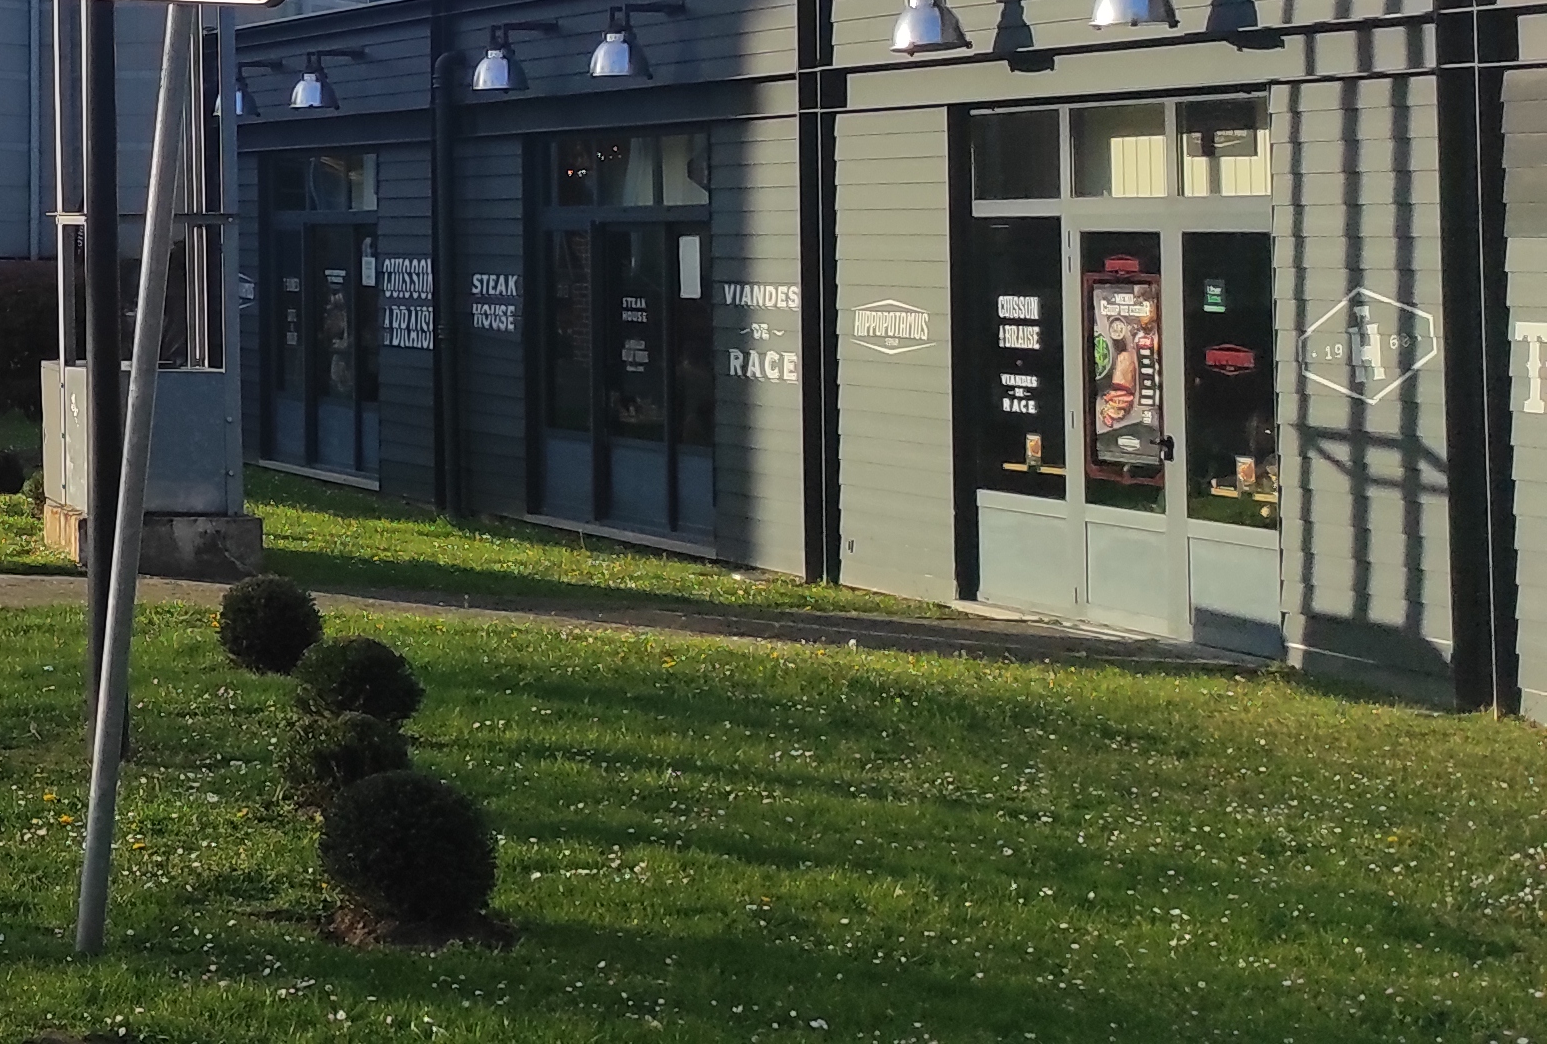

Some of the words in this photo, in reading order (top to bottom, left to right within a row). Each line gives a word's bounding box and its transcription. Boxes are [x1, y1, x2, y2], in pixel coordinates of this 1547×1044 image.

[471, 273, 519, 297] STEAK
[622, 297, 647, 309] STEAK
[723, 284, 800, 311] VIANDES
[998, 295, 1040, 320] CUISSON
[472, 303, 516, 332] HOUSE
[622, 311, 648, 322] HOUSE
[853, 309, 929, 341] HIPPOPOTAMUS
[751, 322, 770, 341] DE
[1004, 324, 1041, 350] BRAISE
[1325, 343, 1343, 360] 19
[728, 348, 799, 385] RACE
[1000, 373, 1038, 388] VIANDES
[1002, 398, 1038, 414] RACE
